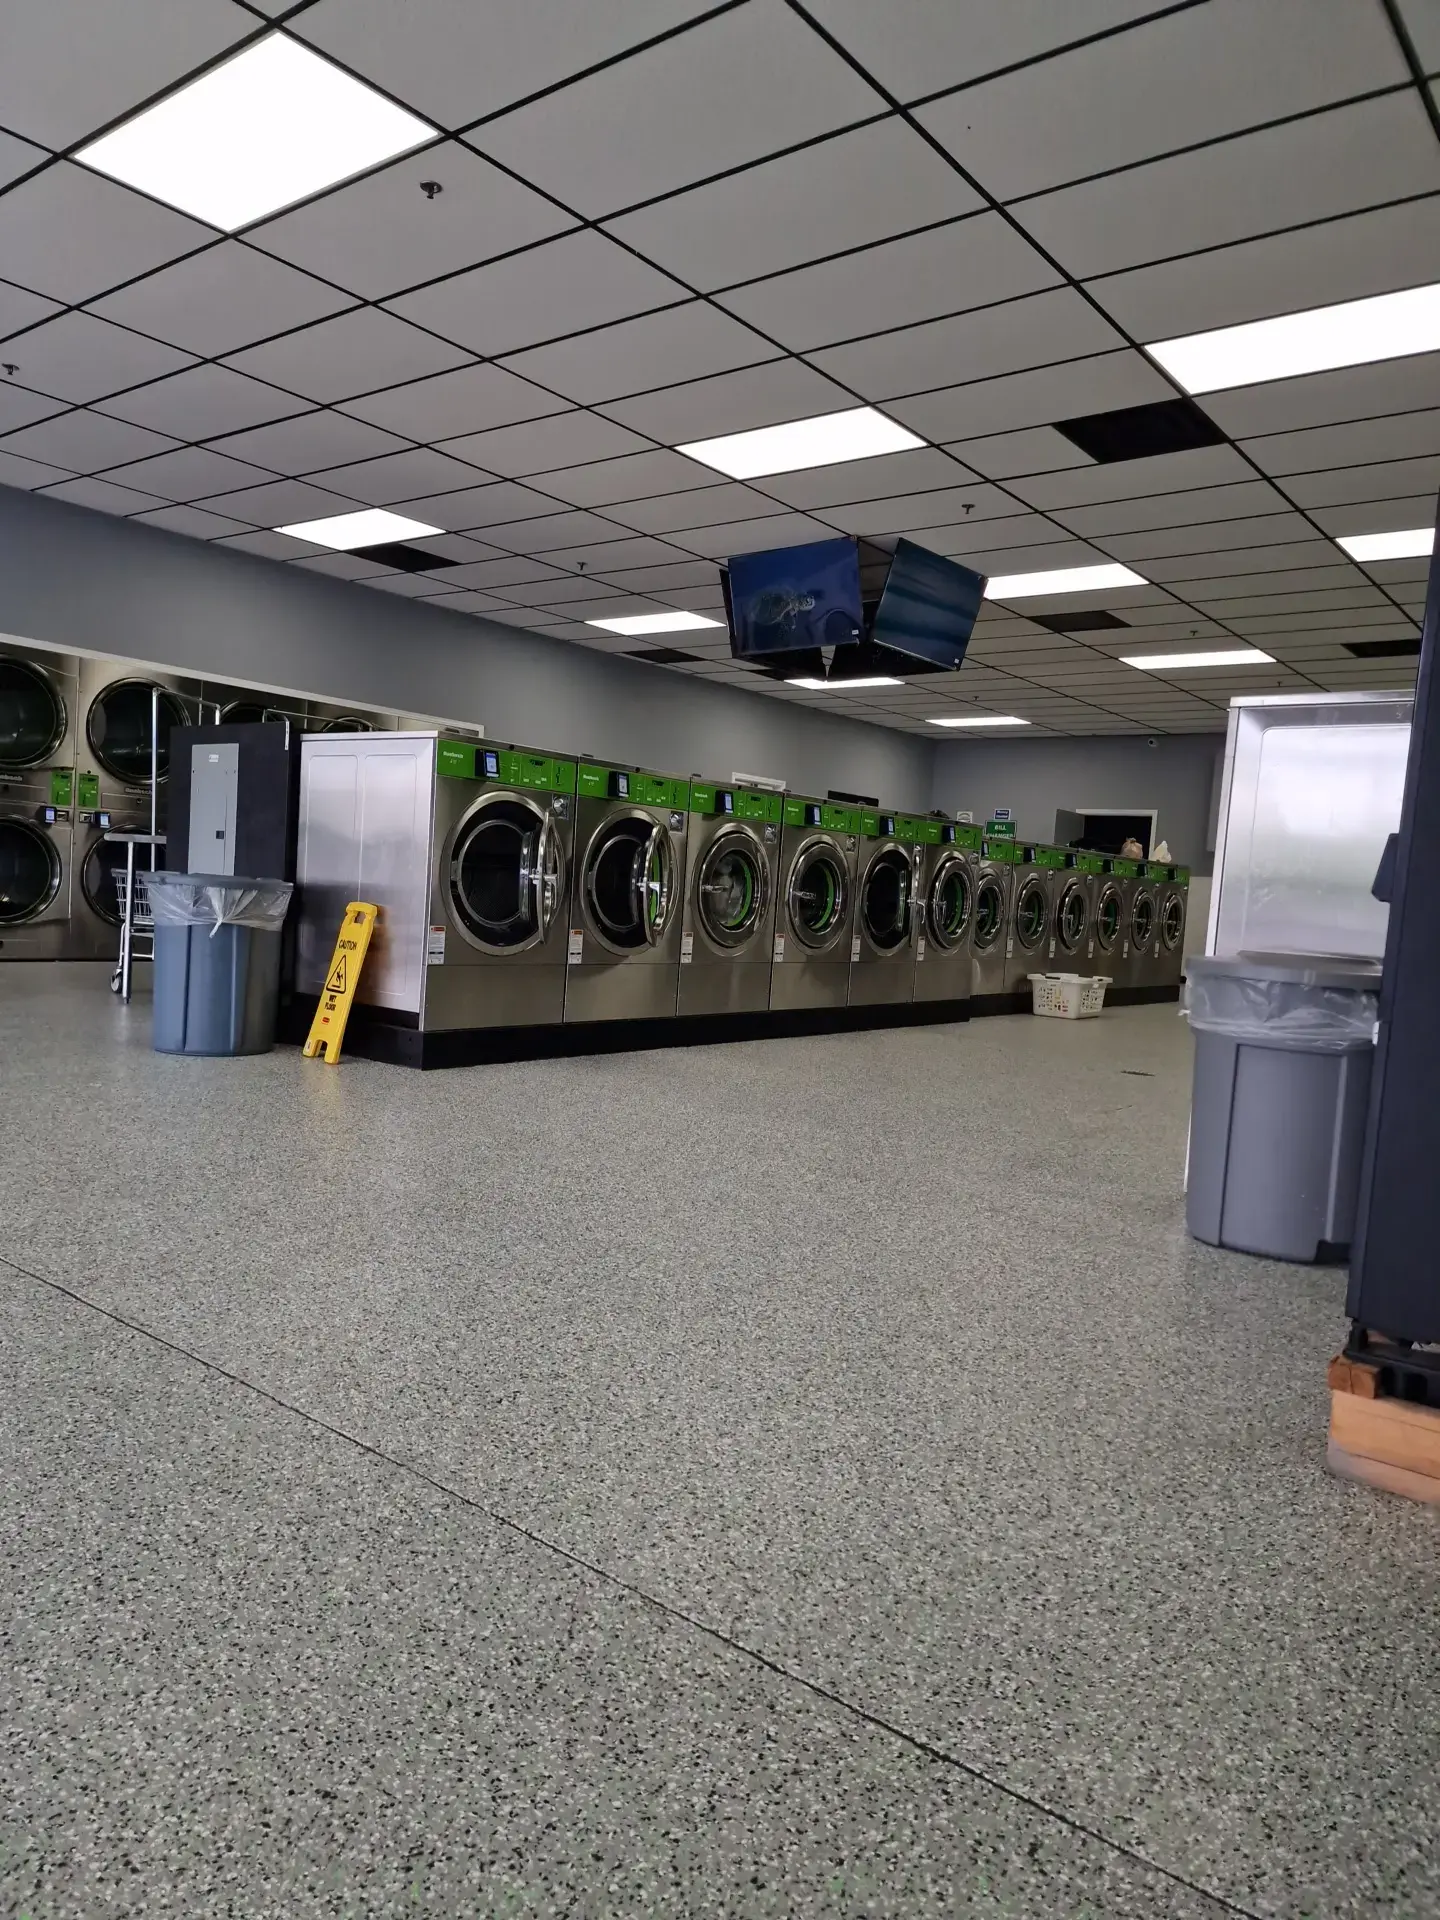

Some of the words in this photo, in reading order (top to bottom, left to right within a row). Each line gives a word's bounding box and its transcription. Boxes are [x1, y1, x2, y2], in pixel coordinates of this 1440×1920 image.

[338, 939, 357, 950] CAUTION
[328, 994, 336, 1002] WET
[325, 1002, 336, 1010] FLOOR
